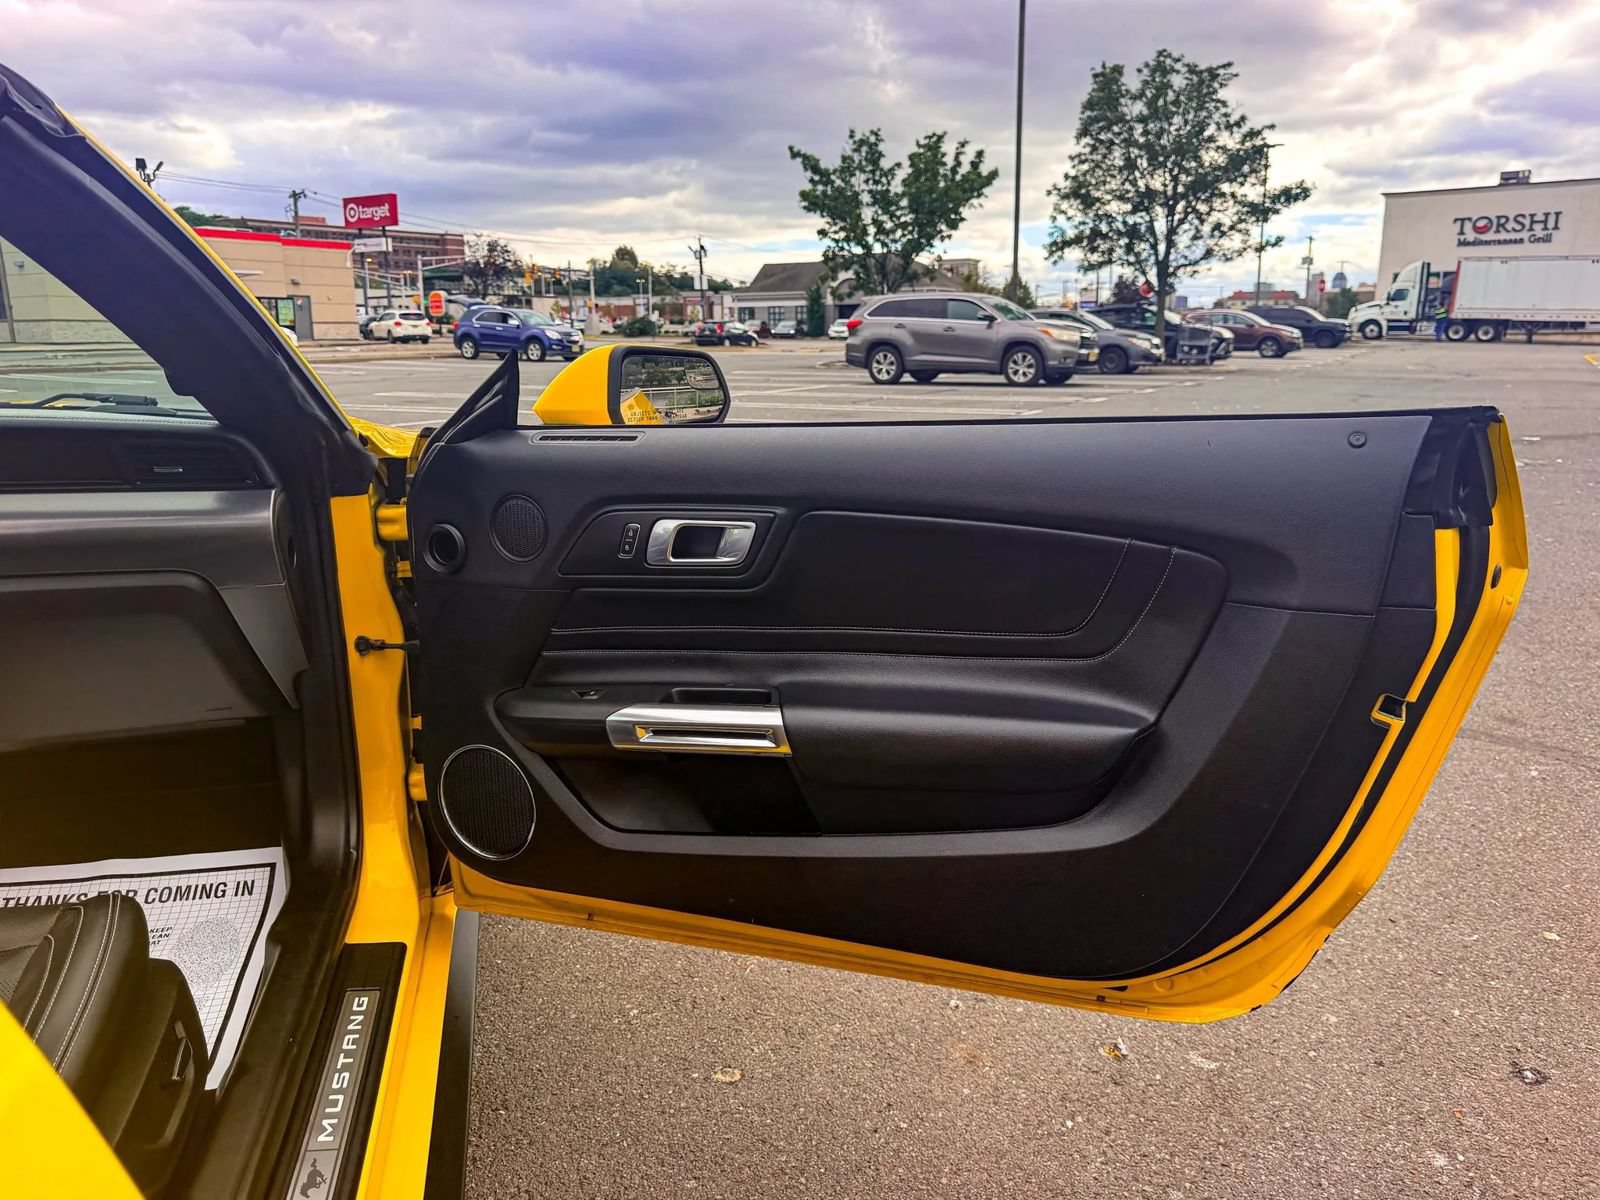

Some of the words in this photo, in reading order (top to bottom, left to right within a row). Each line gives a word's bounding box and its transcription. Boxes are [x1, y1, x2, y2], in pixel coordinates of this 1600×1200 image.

[358, 203, 391, 221] target
[1453, 211, 1562, 236] TORSHI
[1457, 237, 1525, 247] Mediterranean
[1528, 233, 1553, 243] Grill
[144, 882, 228, 904] COMING
[234, 880, 255, 897] IN
[317, 996, 369, 1142] MUSTANG
